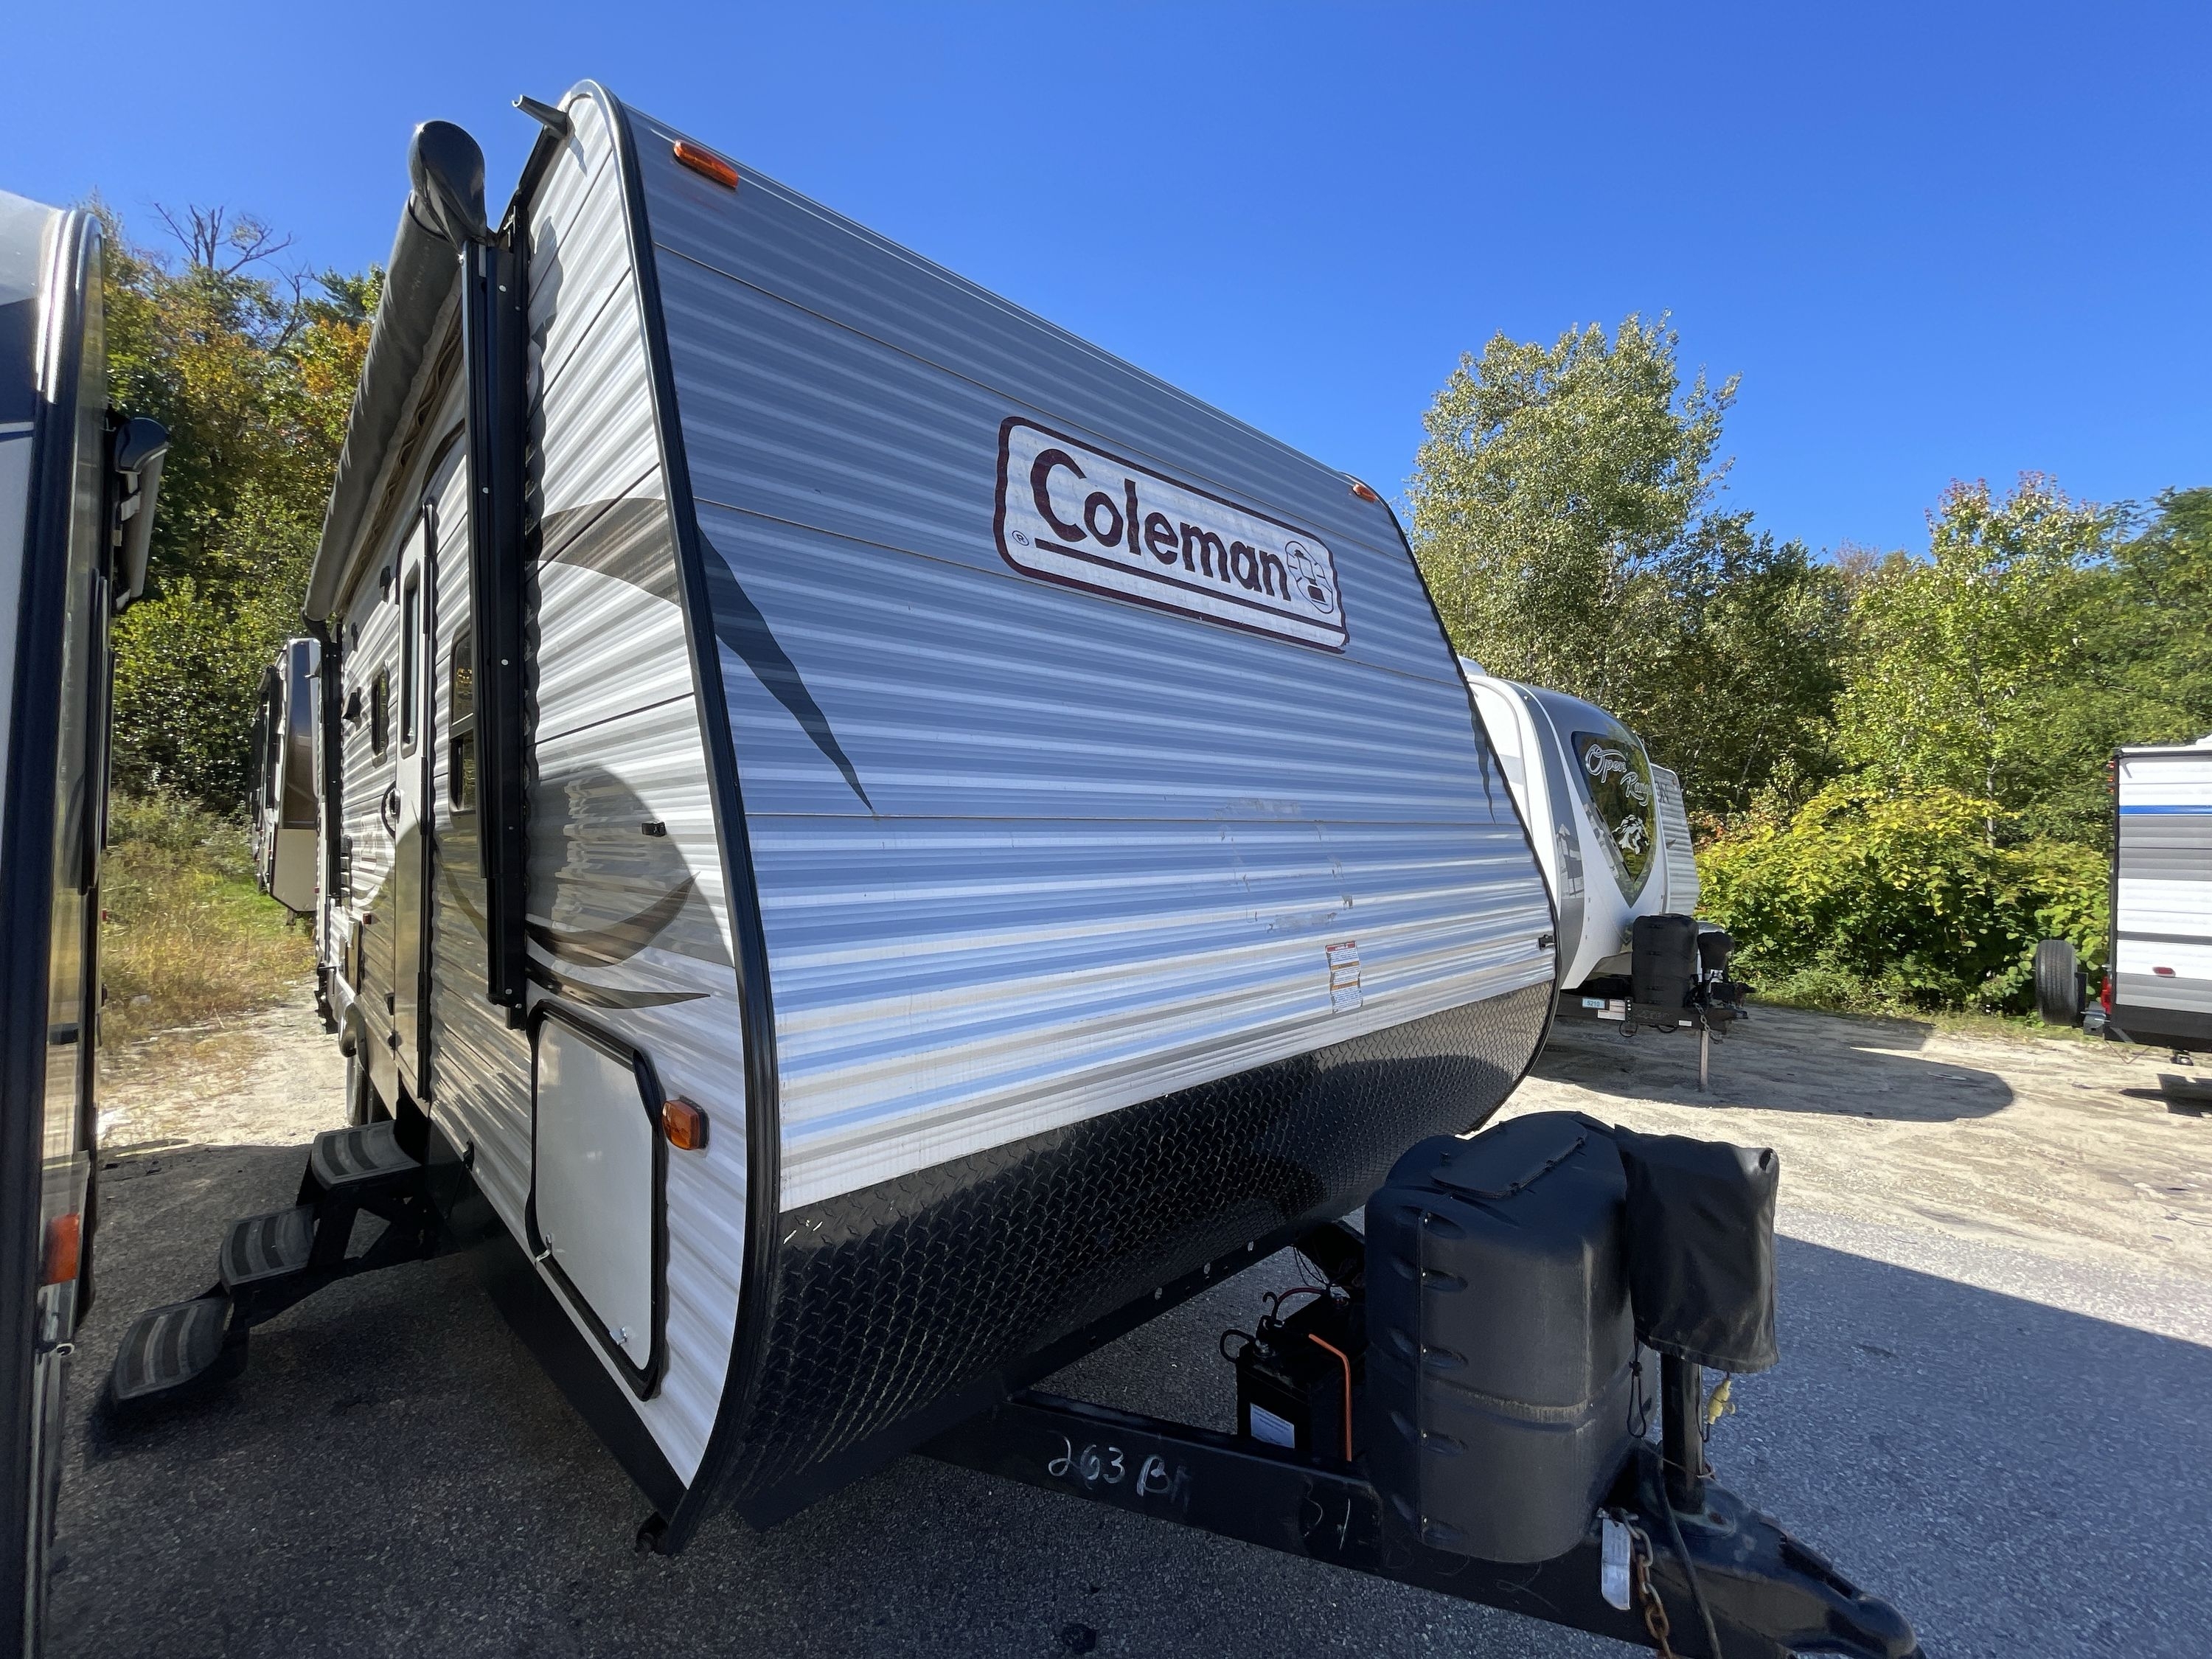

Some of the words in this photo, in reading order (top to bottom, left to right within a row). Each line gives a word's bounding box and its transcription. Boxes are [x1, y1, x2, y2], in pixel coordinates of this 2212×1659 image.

[1030, 448, 1292, 602] Coleman
[1585, 743, 1627, 784] Open
[1047, 1430, 1125, 1490] 263
